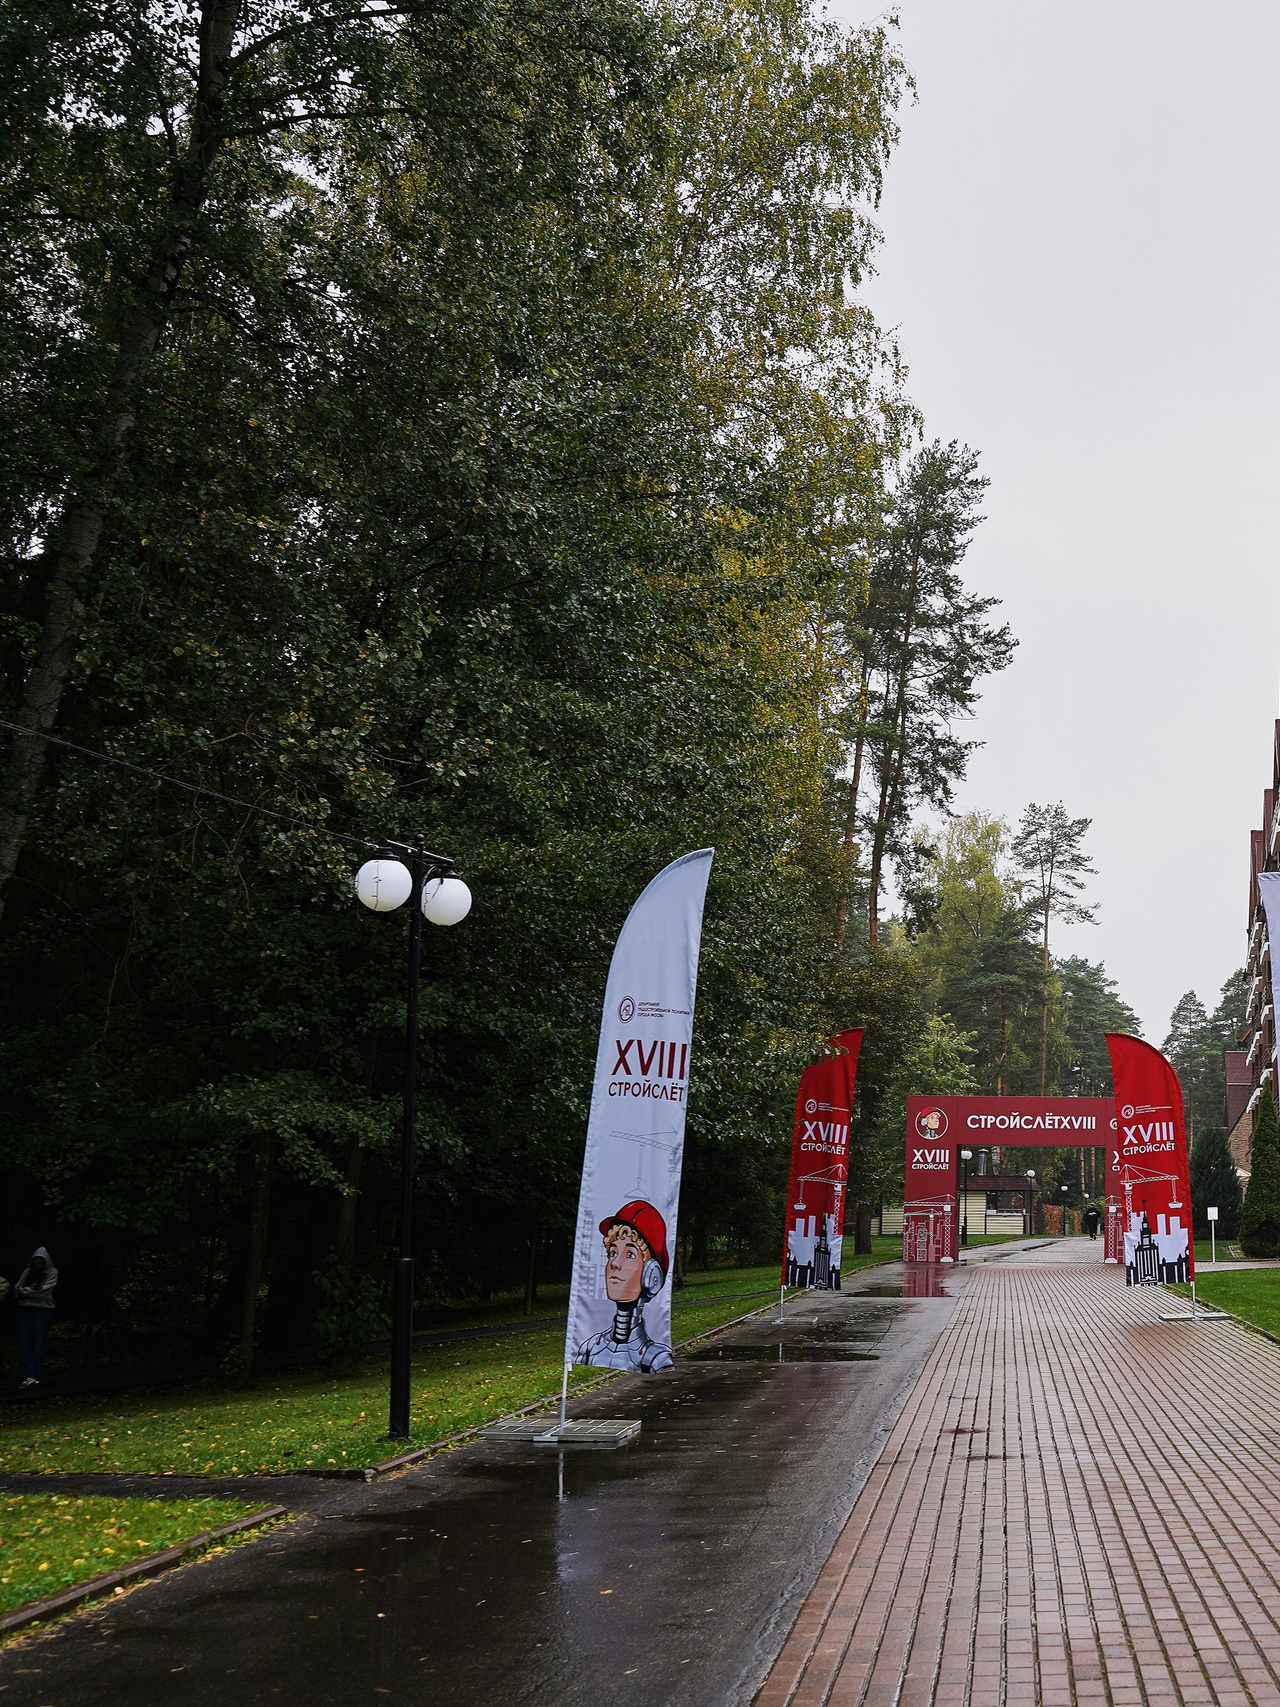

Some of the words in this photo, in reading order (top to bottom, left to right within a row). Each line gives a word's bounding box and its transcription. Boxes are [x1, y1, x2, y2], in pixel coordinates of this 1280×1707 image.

[611, 1039, 687, 1080] XVIII
[608, 1079, 684, 1102] СТРОЙСЛЁТ
[802, 1120, 848, 1145] XVIII
[1122, 1121, 1174, 1145] XVIII
[800, 1142, 846, 1156] СТРОЙСЛЁТ
[912, 1149, 950, 1163] XVIII
[1122, 1141, 1175, 1156] СТРОЙСЛЁТ
